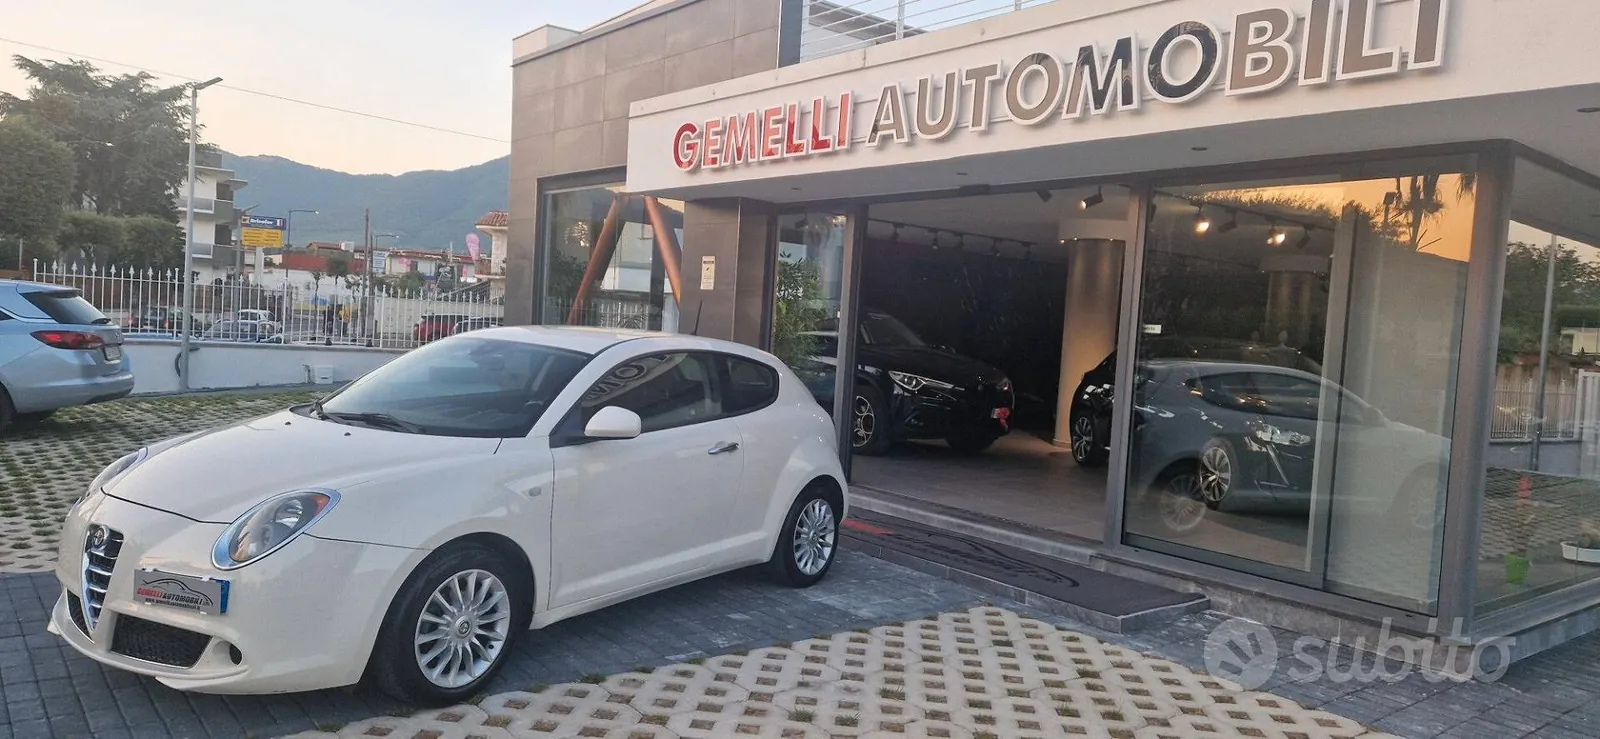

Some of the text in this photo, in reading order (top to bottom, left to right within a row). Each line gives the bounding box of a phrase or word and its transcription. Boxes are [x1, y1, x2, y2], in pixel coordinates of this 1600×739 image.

[672, 0, 1446, 171] GEMELLI AUTOMOBILI
[162, 592, 203, 605] AUTOMOBILI
